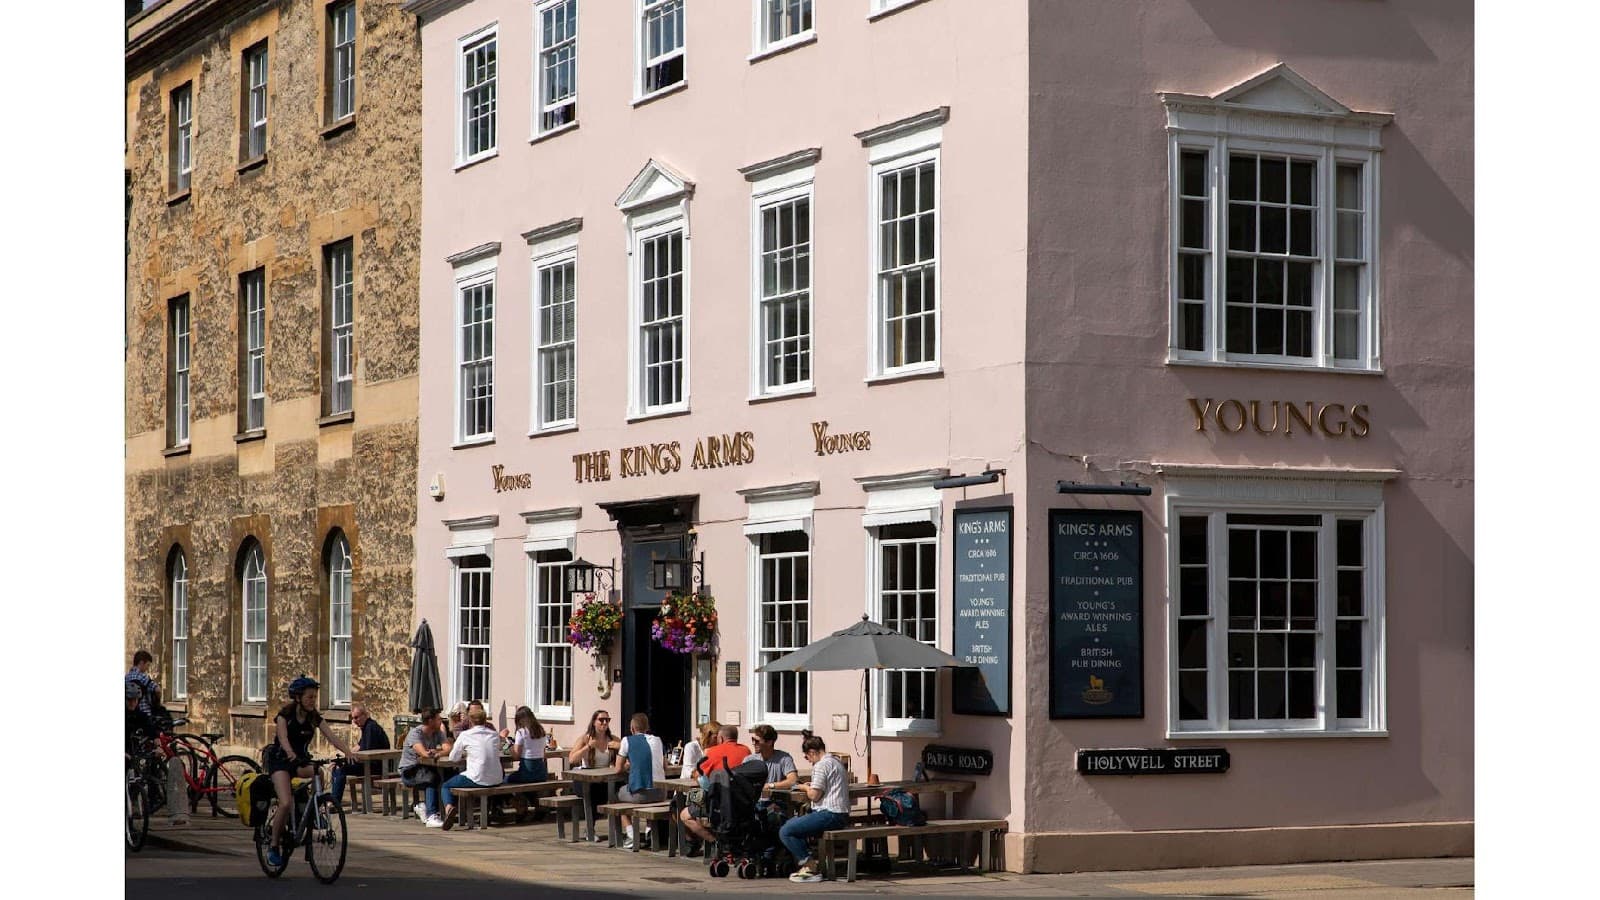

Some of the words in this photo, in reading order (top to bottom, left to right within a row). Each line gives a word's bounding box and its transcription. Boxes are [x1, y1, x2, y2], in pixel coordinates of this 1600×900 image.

[1187, 398, 1370, 438] YOUNGS
[572, 450, 611, 483] THE
[690, 431, 754, 470] ARMS
[983, 520, 1006, 533] ARMS
[1058, 523, 1096, 536] KING'S
[1098, 524, 1133, 536] ARMS
[1073, 551, 1099, 560] CIRCA
[1100, 551, 1119, 560] 1606
[1060, 576, 1115, 585] TRADITIONAL
[1116, 577, 1133, 585] PUB
[1077, 601, 1116, 610] YOUNG'S
[1061, 612, 1091, 621] AWARD
[1092, 612, 1132, 621] WINNING
[975, 620, 989, 629] ALES
[1085, 623, 1108, 632] ALES
[1081, 648, 1113, 657] BRITISH
[978, 656, 999, 664] DINING
[1071, 660, 1089, 668] PUB
[1091, 660, 1122, 668] DINING
[927, 752, 954, 767] PARKS
[959, 755, 985, 769] ROAD
[1087, 756, 1165, 770] HOLYWELL
[1174, 755, 1221, 768] STREET
